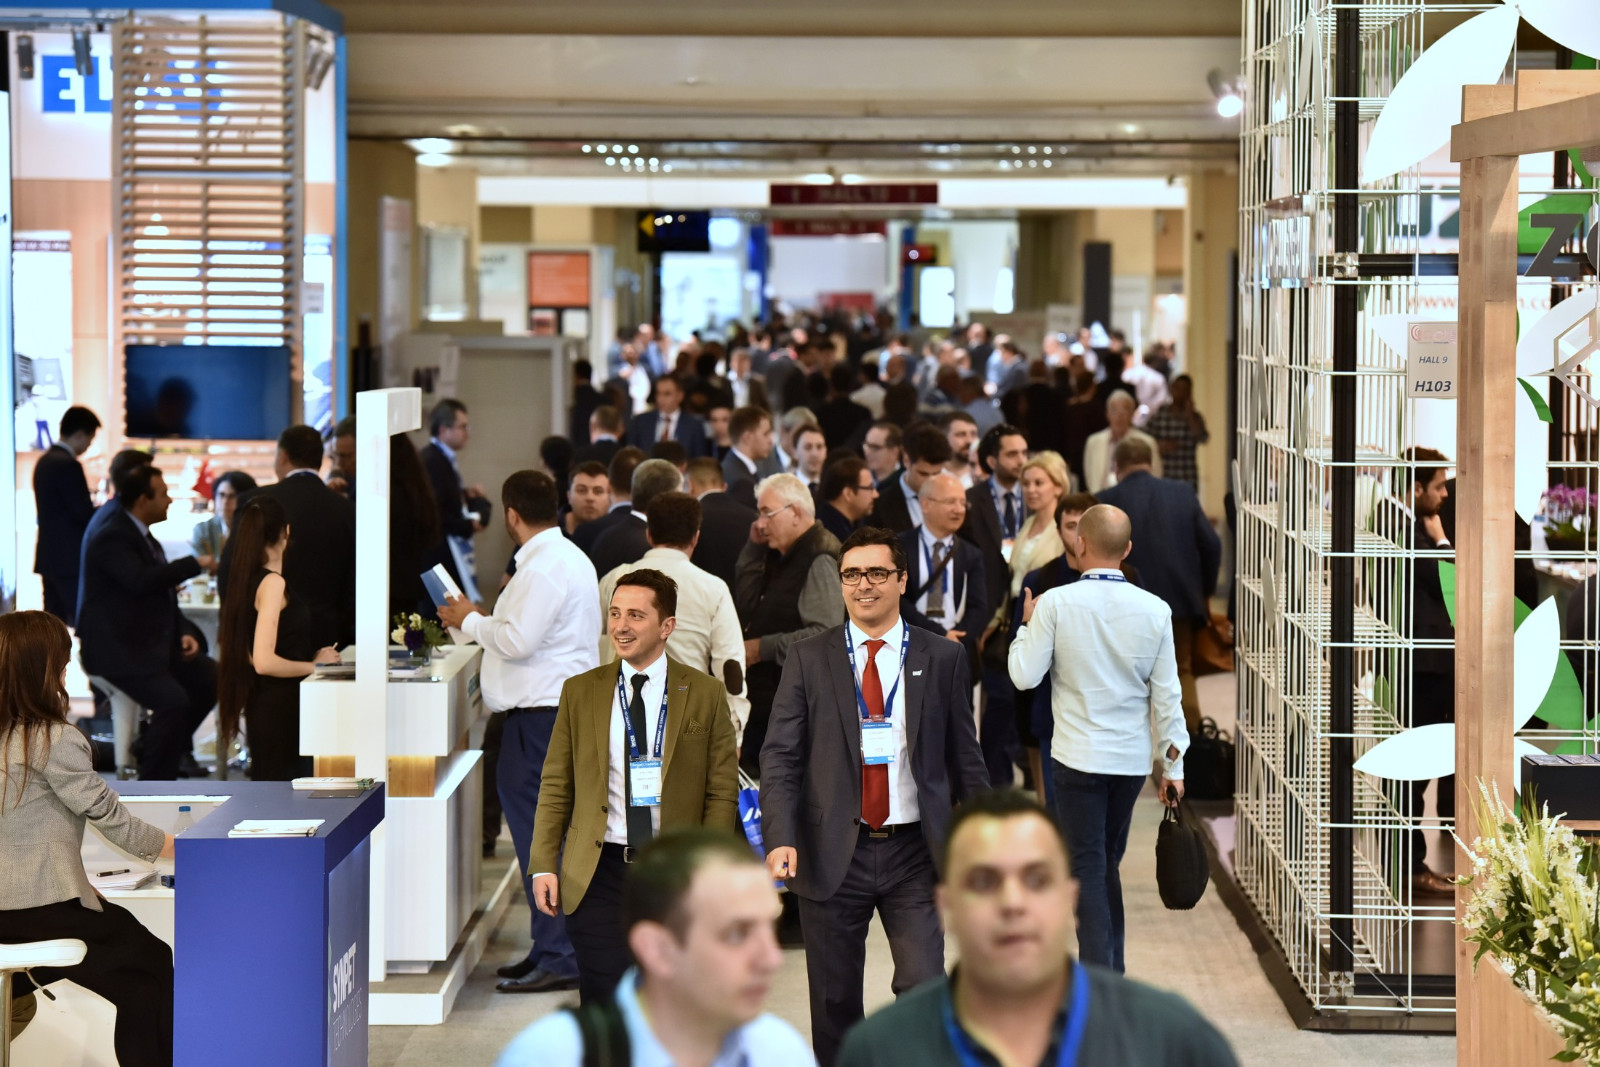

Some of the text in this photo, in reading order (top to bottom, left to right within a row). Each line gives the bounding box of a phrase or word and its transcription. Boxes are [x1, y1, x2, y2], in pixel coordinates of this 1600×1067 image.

[1523, 213, 1600, 277] Z
[1418, 355, 1448, 364] HALL 9
[1414, 380, 1452, 392] H103
[333, 941, 357, 1014] SYNPET
